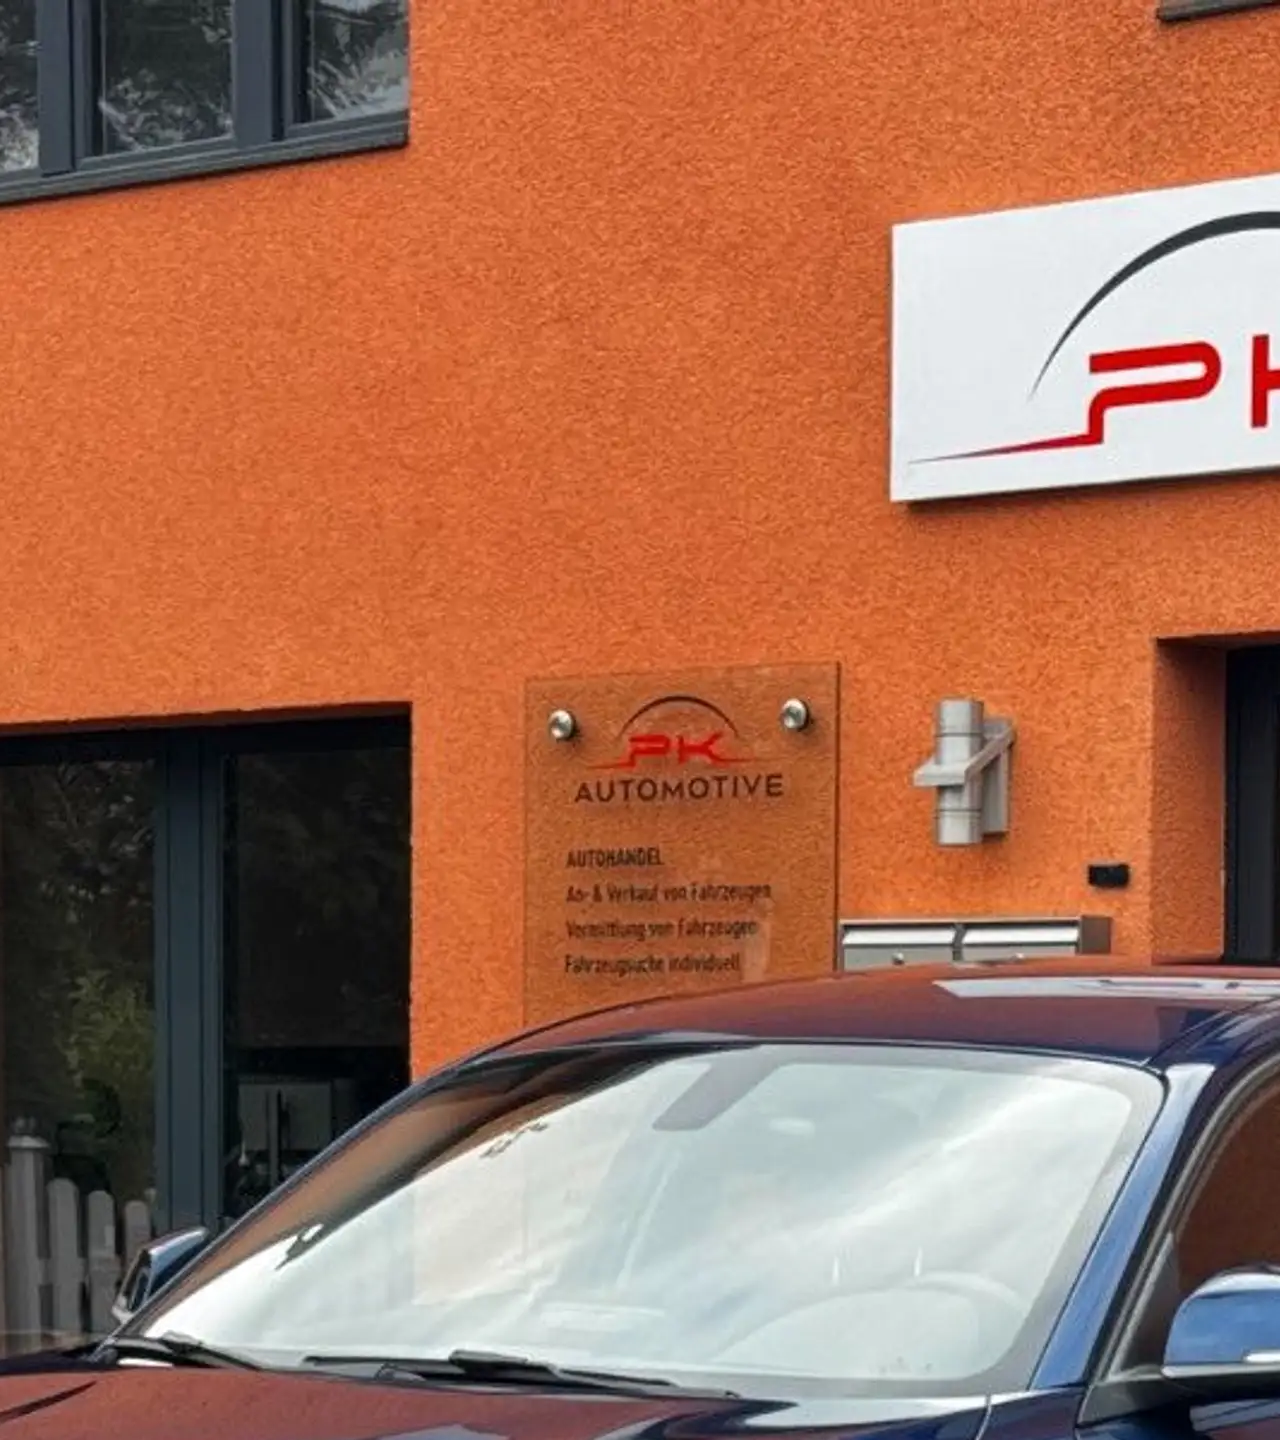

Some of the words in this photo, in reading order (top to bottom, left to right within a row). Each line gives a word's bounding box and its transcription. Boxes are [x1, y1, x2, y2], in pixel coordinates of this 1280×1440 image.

[627, 732, 724, 769] PK
[573, 773, 785, 803] AUTOMOTIVE
[565, 847, 665, 869] AUTOHANDEL
